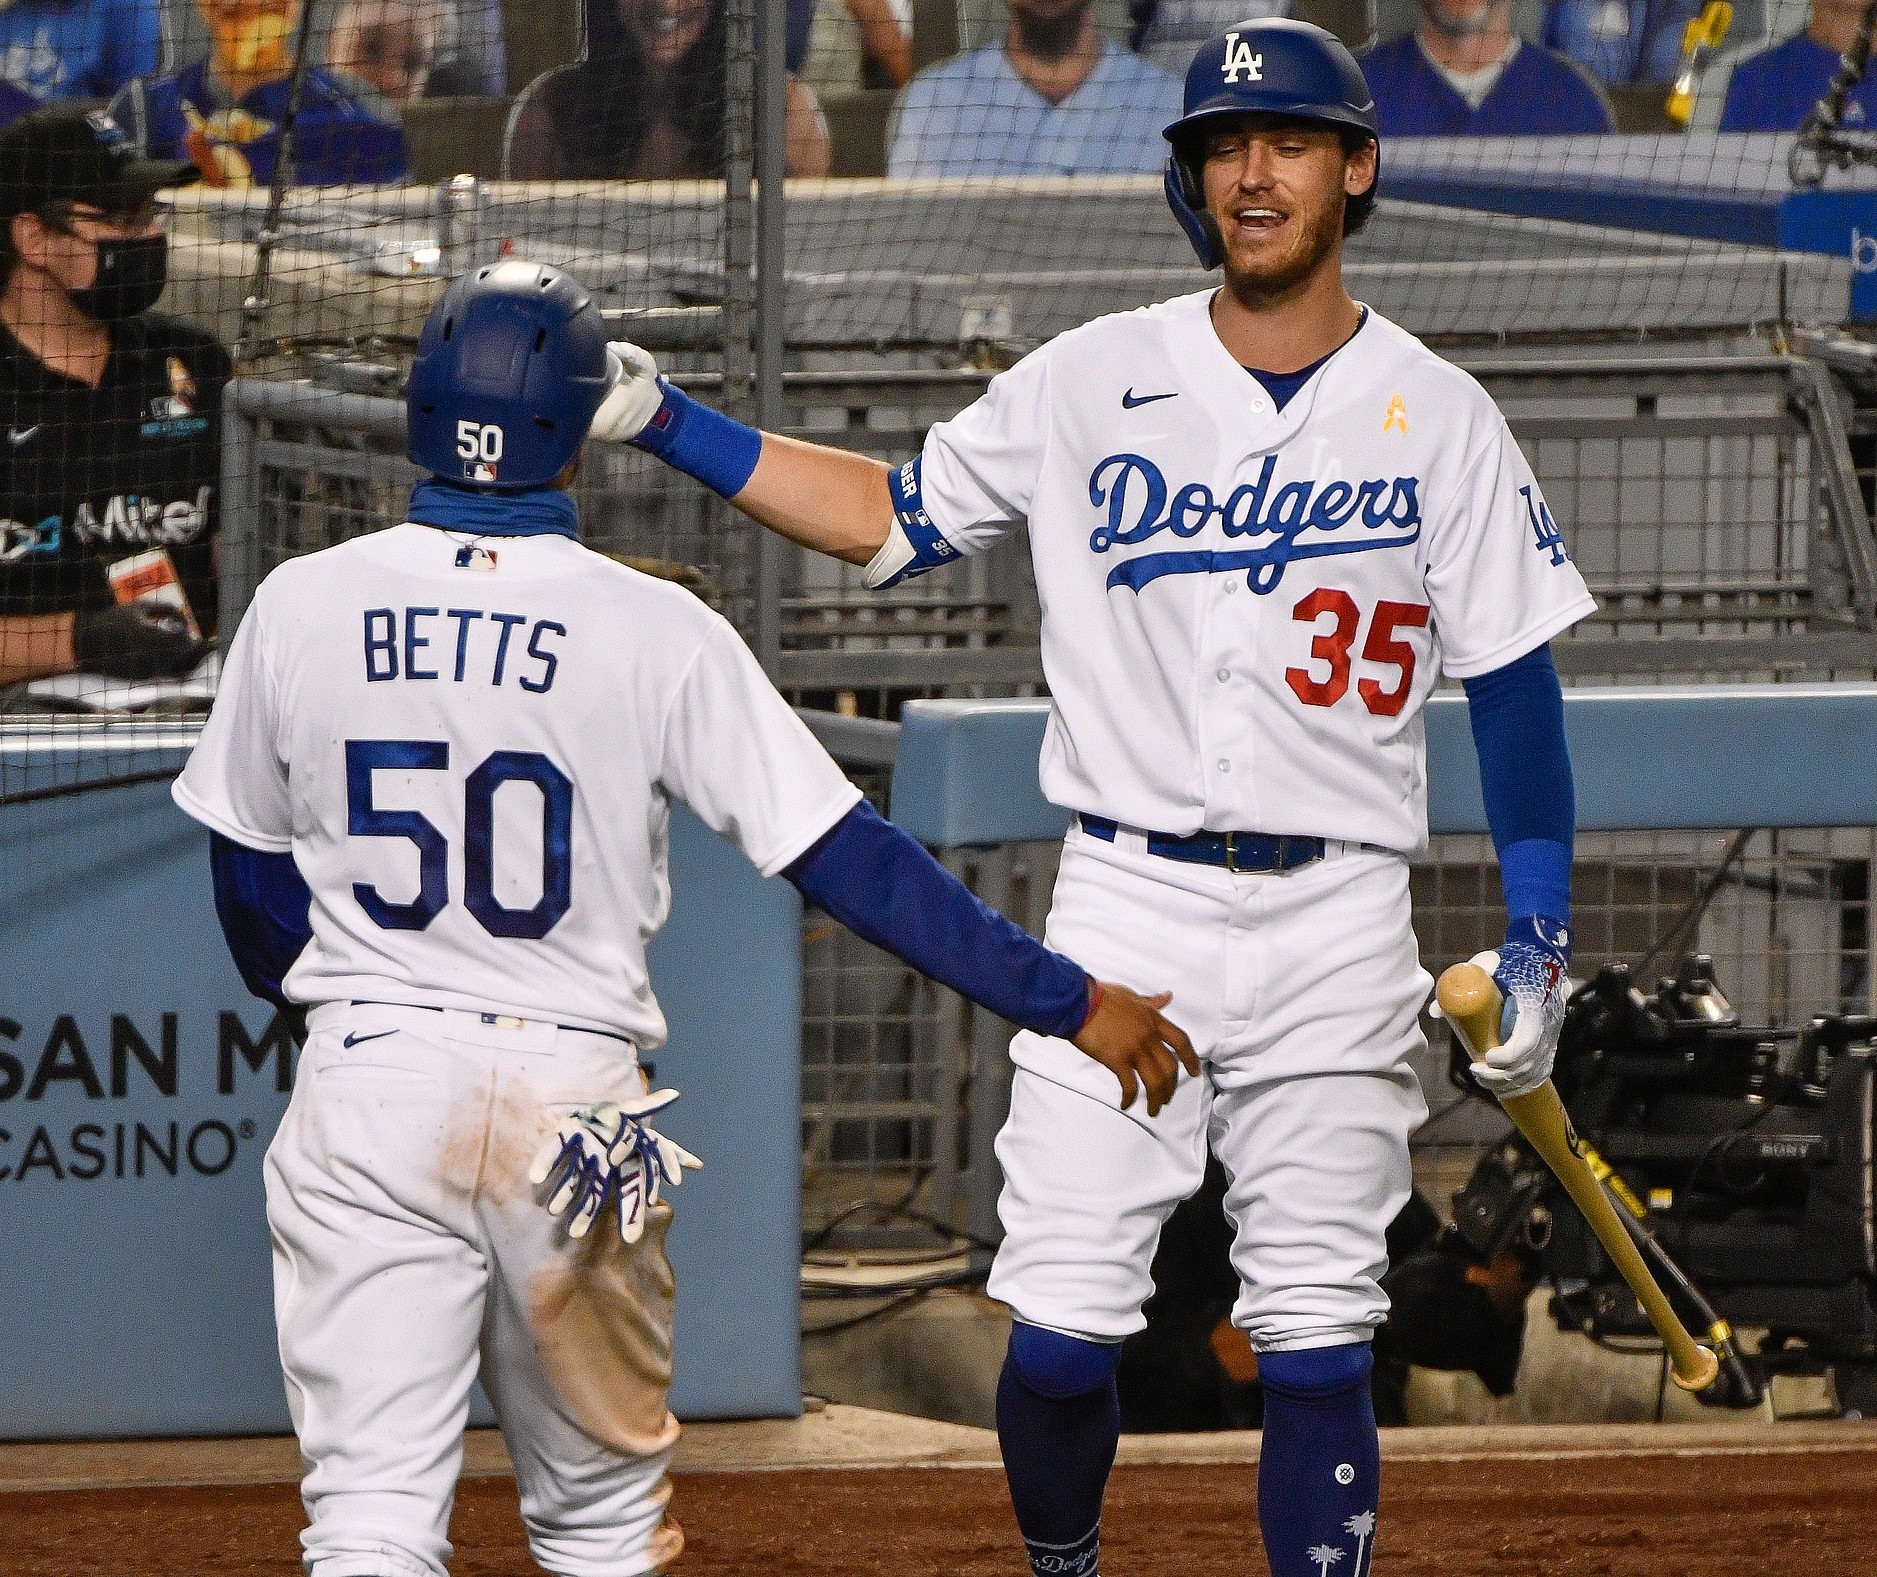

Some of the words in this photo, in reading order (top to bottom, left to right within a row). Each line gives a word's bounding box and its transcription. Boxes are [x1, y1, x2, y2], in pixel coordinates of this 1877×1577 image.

[1221, 32, 1263, 84] LA
[457, 419, 504, 461] 50
[901, 460, 918, 499] GER
[931, 539, 955, 557] 35
[1089, 453, 1421, 595] Dodgers
[363, 605, 568, 695] BETTS
[1285, 587, 1431, 717] 35
[344, 738, 574, 939] 50
